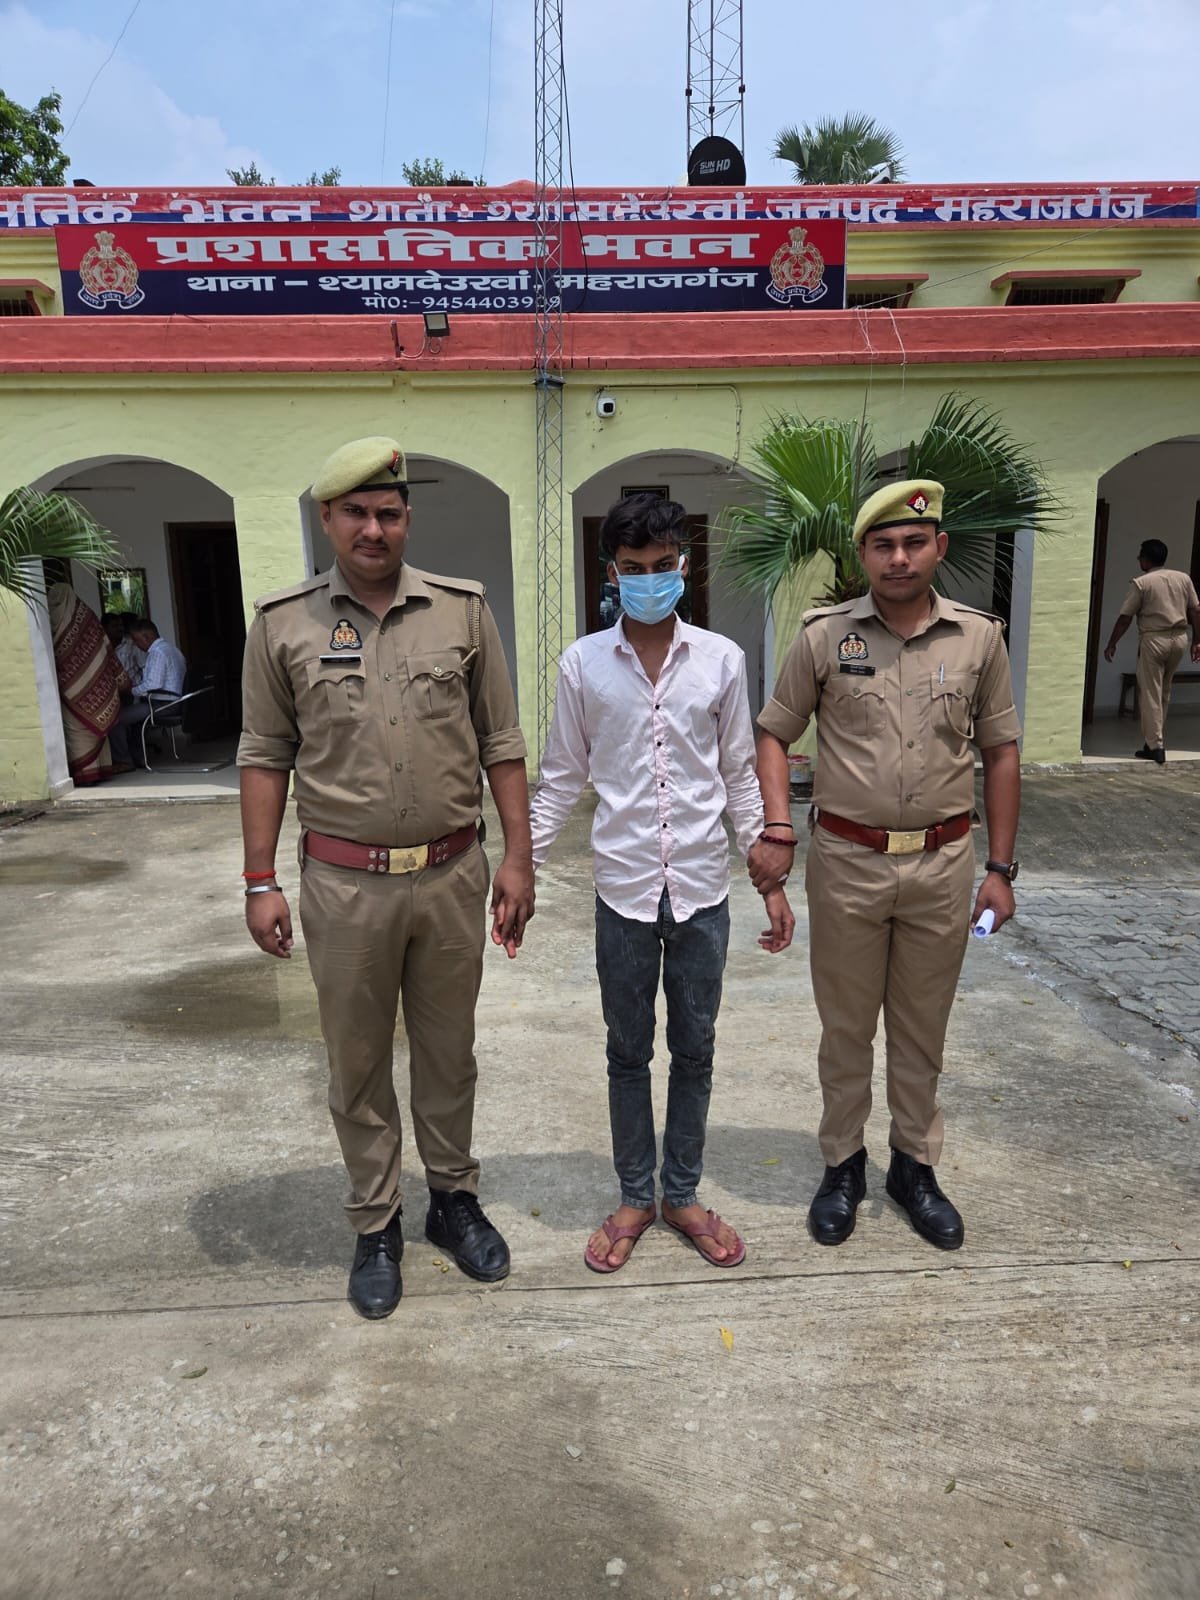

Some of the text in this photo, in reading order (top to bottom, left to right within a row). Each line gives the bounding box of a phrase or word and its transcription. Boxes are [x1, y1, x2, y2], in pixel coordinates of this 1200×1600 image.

[716, 158, 731, 171] HD
[766, 198, 904, 222] जनपद
[931, 187, 1152, 222] महराजगंज
[146, 227, 760, 264] प्रशासनिक भवन
[186, 274, 276, 292] थाना
[553, 267, 759, 292] महराजगंज
